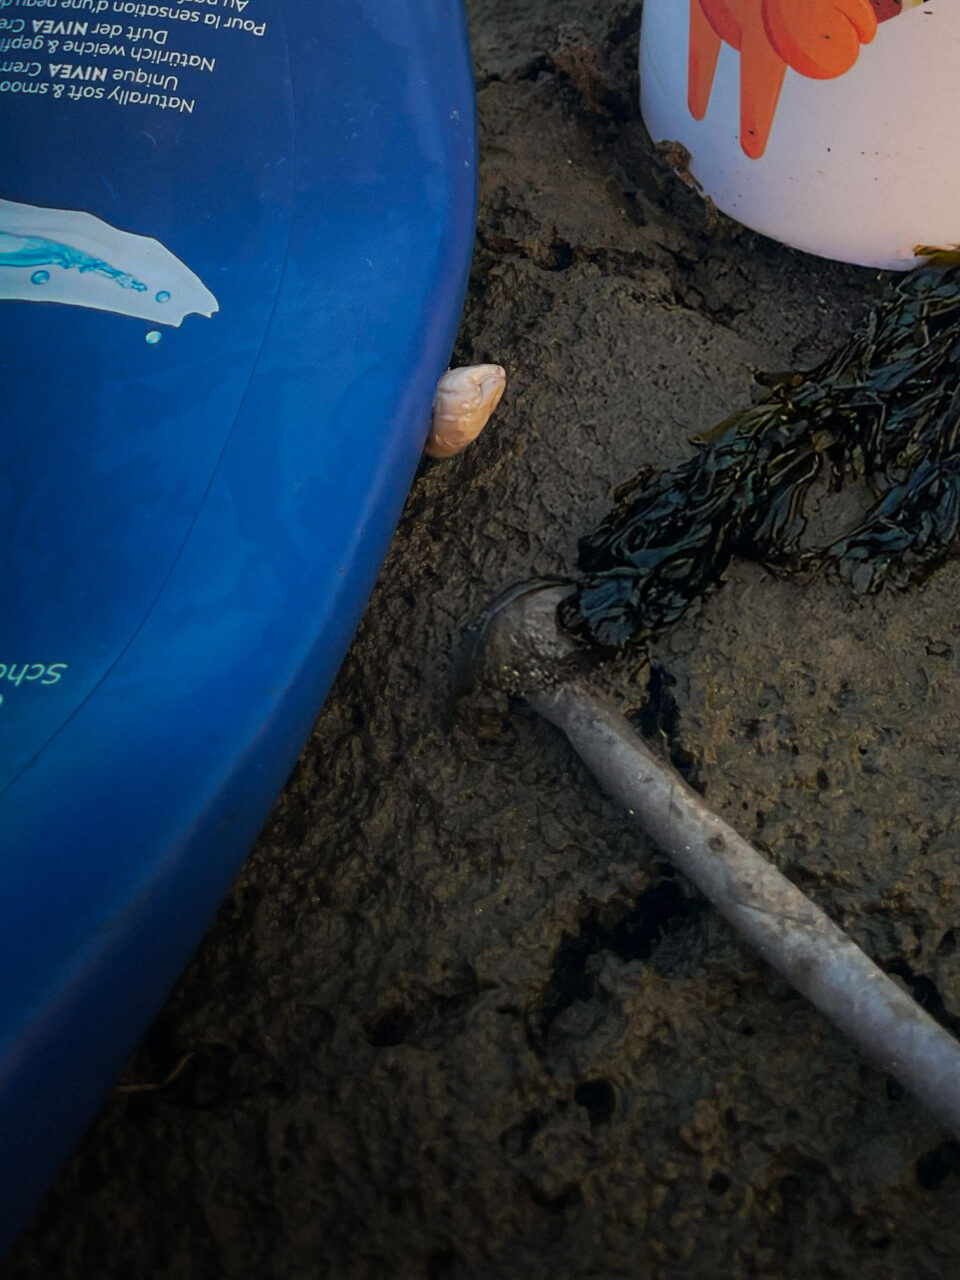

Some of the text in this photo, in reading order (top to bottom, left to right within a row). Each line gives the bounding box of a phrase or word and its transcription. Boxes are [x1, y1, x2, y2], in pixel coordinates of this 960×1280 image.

[112, 3, 201, 23] sensation
[204, 14, 221, 29] la
[32, 19, 89, 37] NIVEA
[91, 24, 122, 39] der
[126, 26, 168, 45] Duft
[222, 18, 266, 37] Pour
[47, 39, 59, 54] &
[63, 40, 125, 58] weiche
[130, 46, 216, 72] Natürlich
[48, 63, 107, 82] NIVEA
[112, 68, 179, 92] Unique
[52, 83, 64, 99] &
[67, 83, 105, 101] soft
[107, 85, 195, 114] Naturally
